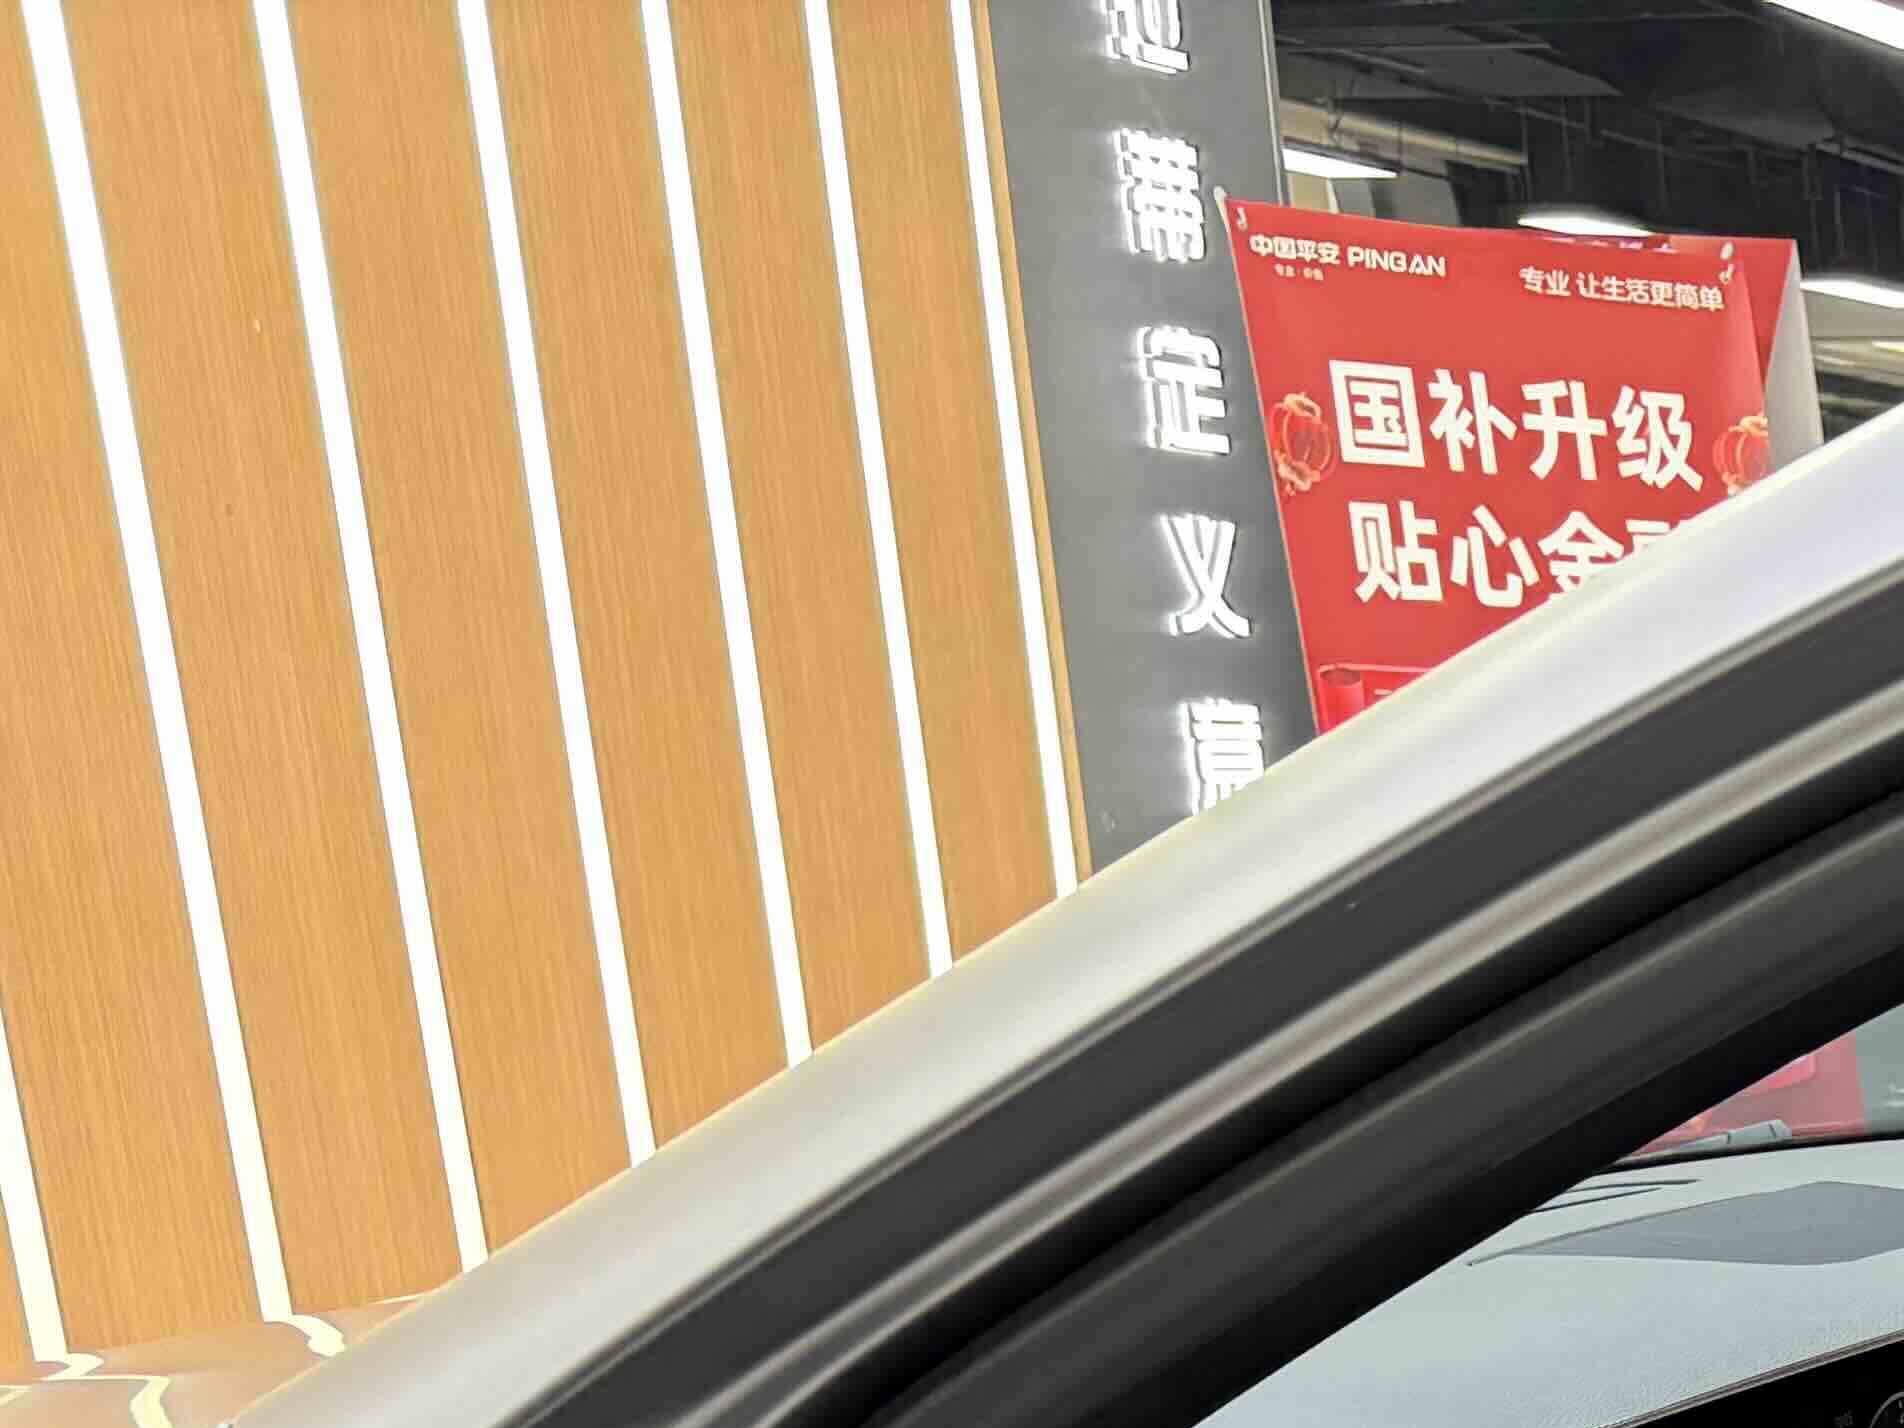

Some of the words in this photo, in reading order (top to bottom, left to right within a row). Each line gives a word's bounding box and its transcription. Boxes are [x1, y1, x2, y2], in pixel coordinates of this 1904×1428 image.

[1250, 234, 1341, 266] 中国平安
[1346, 245, 1447, 278] PINGAN
[1518, 264, 1571, 298] 专业
[1575, 271, 1725, 313] 让生活更简单
[1329, 359, 1705, 492] 国补升级
[1347, 499, 1675, 610] 贴心金
